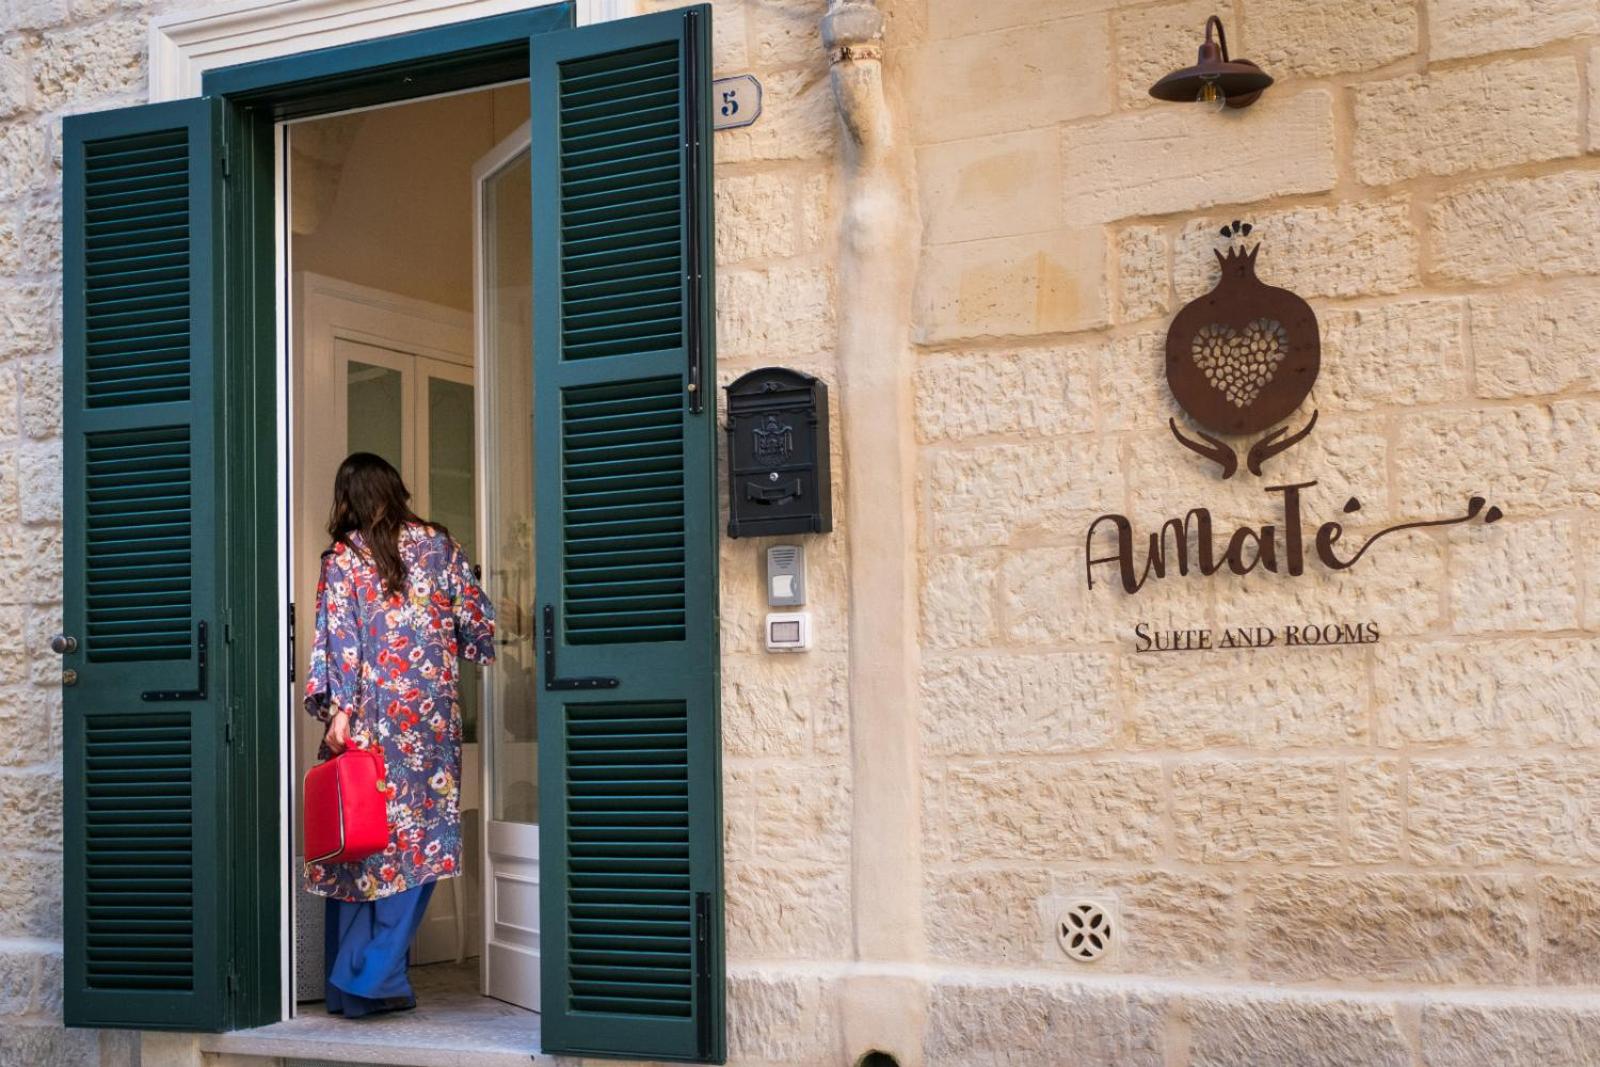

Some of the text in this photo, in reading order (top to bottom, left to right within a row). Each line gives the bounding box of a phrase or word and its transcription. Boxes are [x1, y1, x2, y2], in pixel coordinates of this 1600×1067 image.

[721, 90, 739, 117] 5
[1135, 622, 1380, 653] SUITE AND ROOMS
